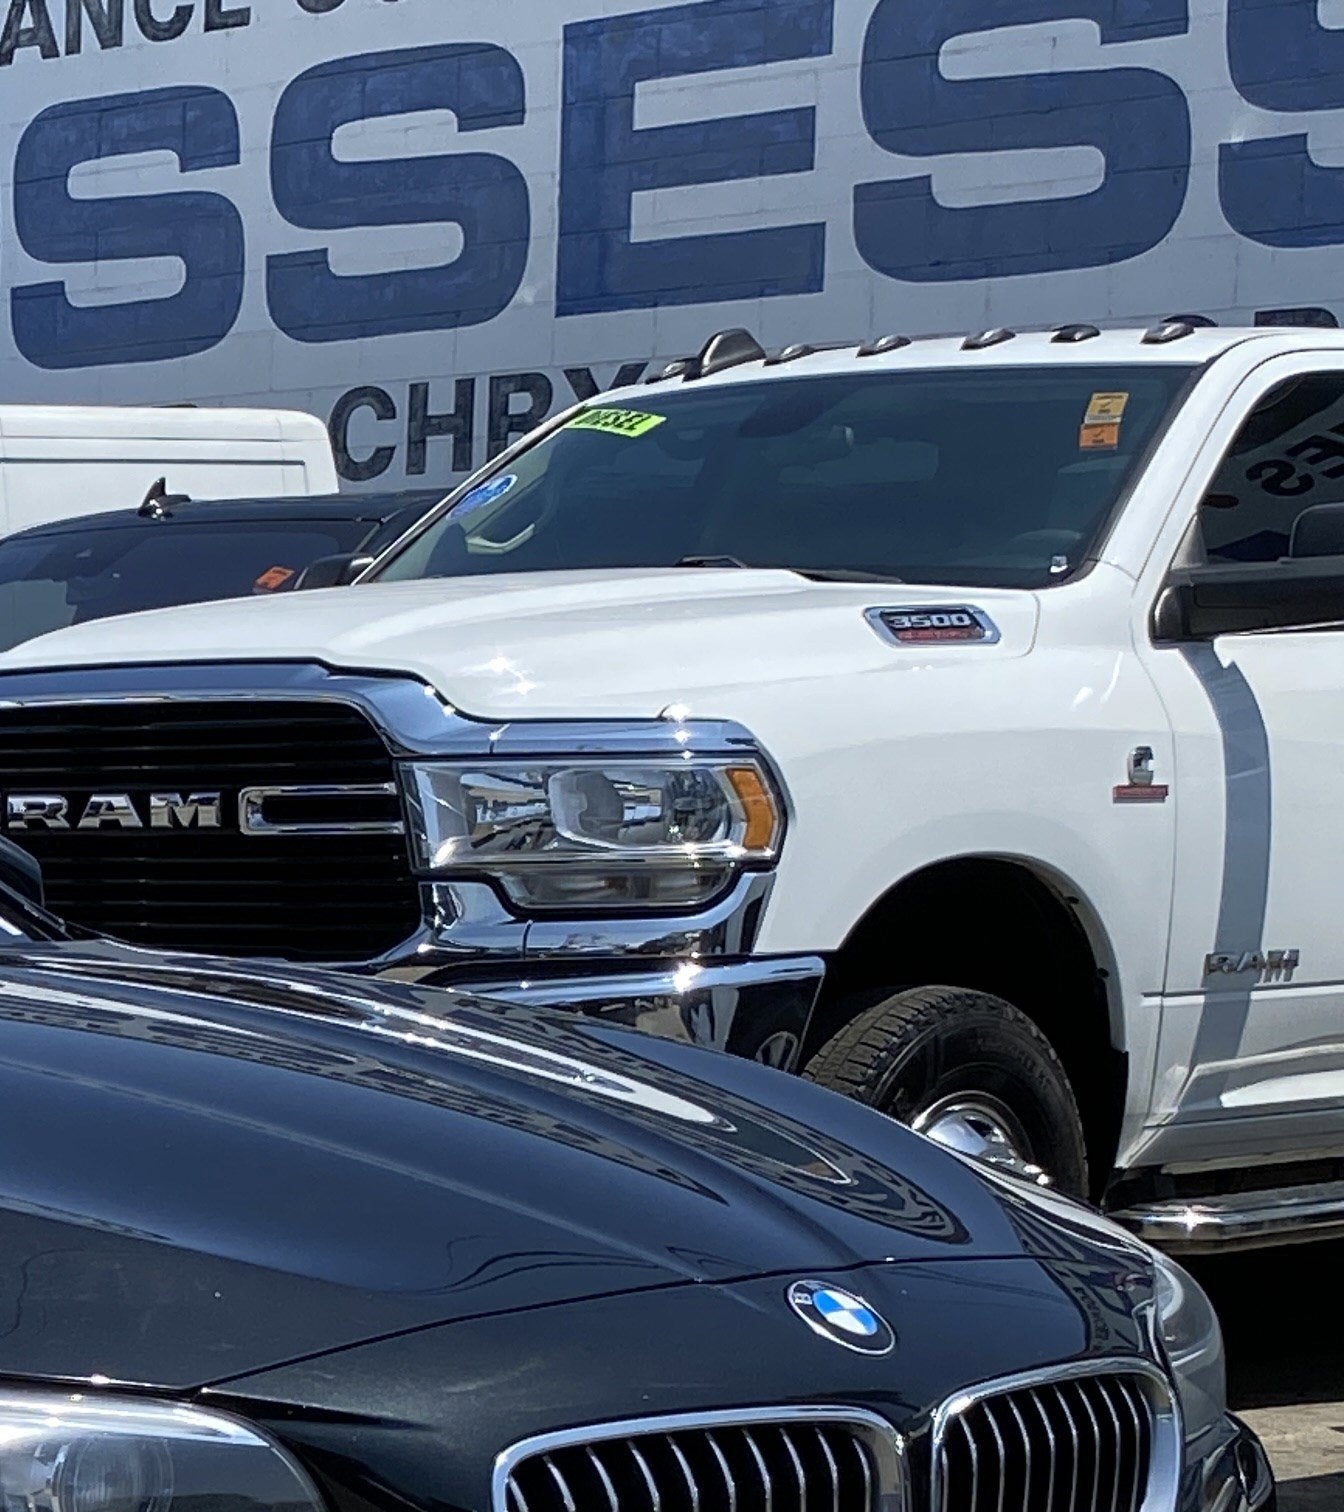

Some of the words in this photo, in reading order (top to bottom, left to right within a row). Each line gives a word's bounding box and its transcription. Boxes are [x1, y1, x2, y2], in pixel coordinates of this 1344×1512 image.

[889, 613, 971, 629] 3500
[6, 792, 221, 829] RAM
[1203, 949, 1299, 983] RAM
